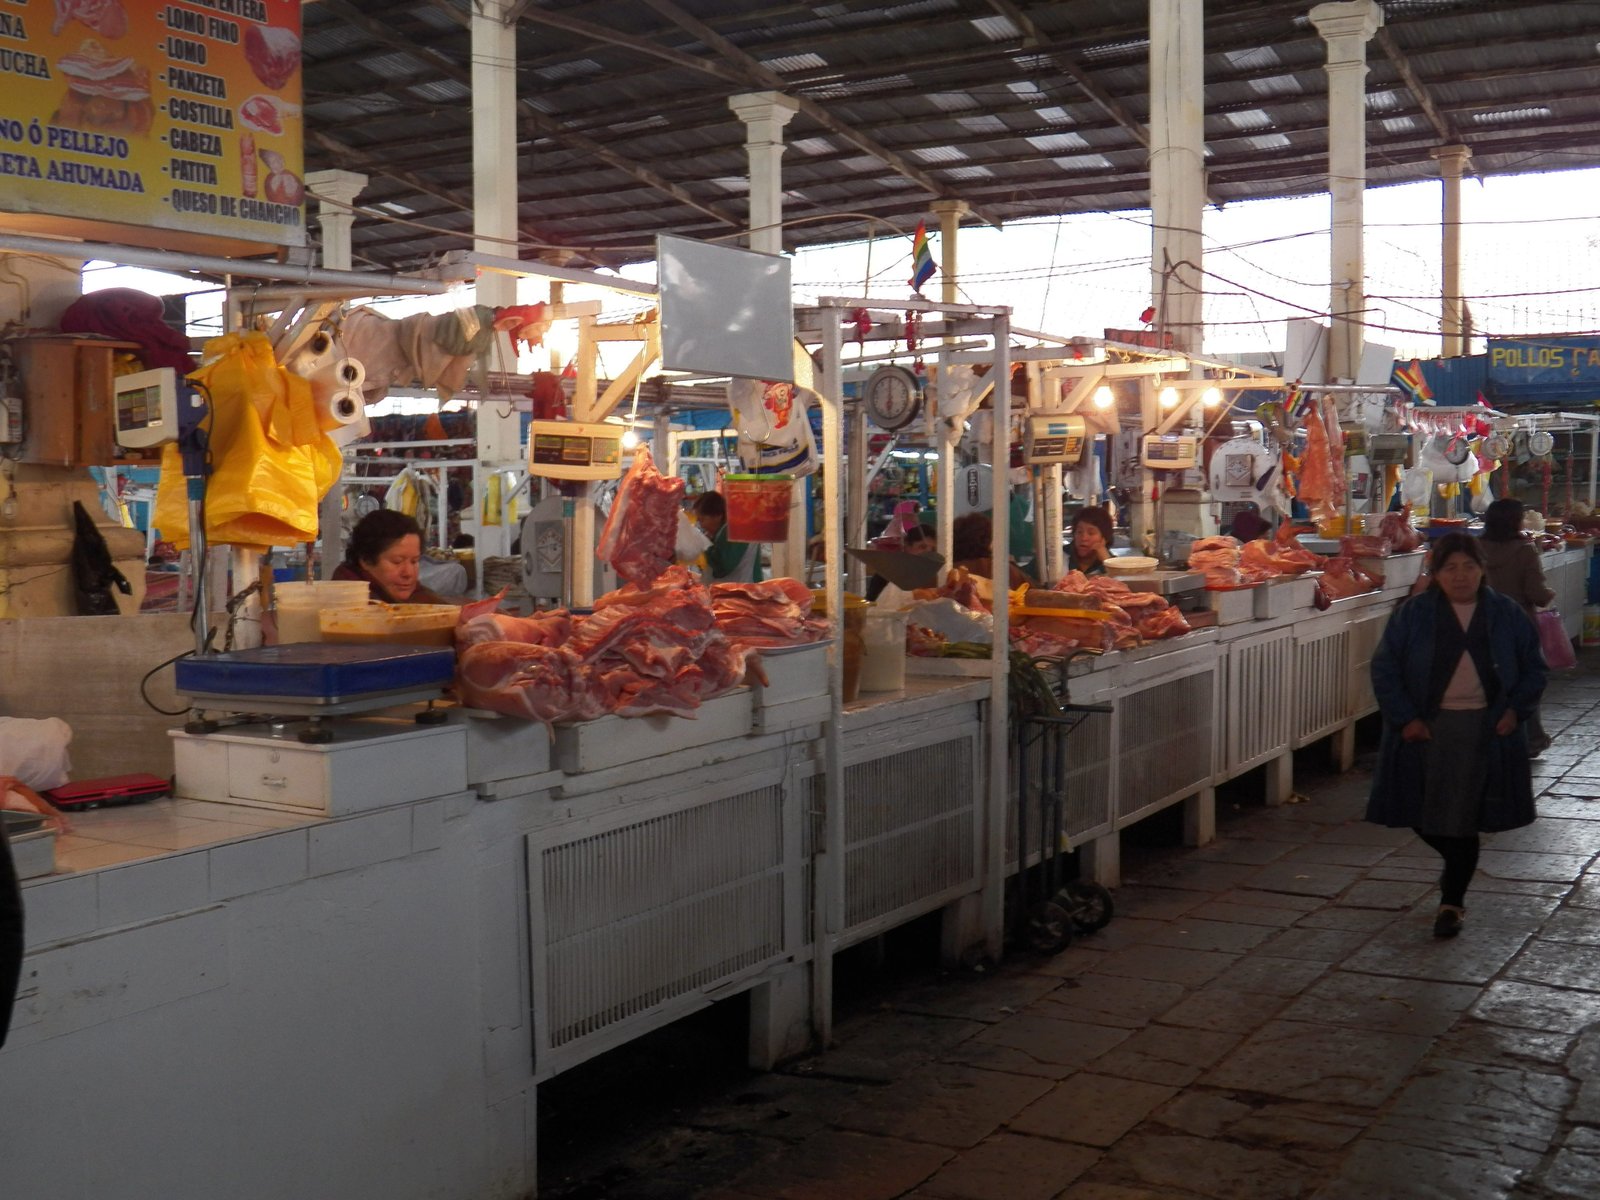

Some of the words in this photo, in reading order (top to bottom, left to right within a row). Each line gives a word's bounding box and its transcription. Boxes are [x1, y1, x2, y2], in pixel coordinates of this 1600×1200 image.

[167, 6, 205, 35] LOMO
[208, 16, 239, 44] FINO
[167, 36, 207, 65] LOMO
[168, 66, 227, 99] PANZETA
[169, 97, 234, 130] COSTILLA
[47, 126, 129, 158] PELLEJO
[170, 127, 223, 157] CABEZA
[47, 160, 145, 193] AHUMADA
[171, 158, 218, 185] PATITA
[172, 188, 217, 214] QUESO
[220, 195, 237, 217] DE
[240, 198, 300, 226] CHANCHO
[1492, 347, 1564, 368] POLLOS
